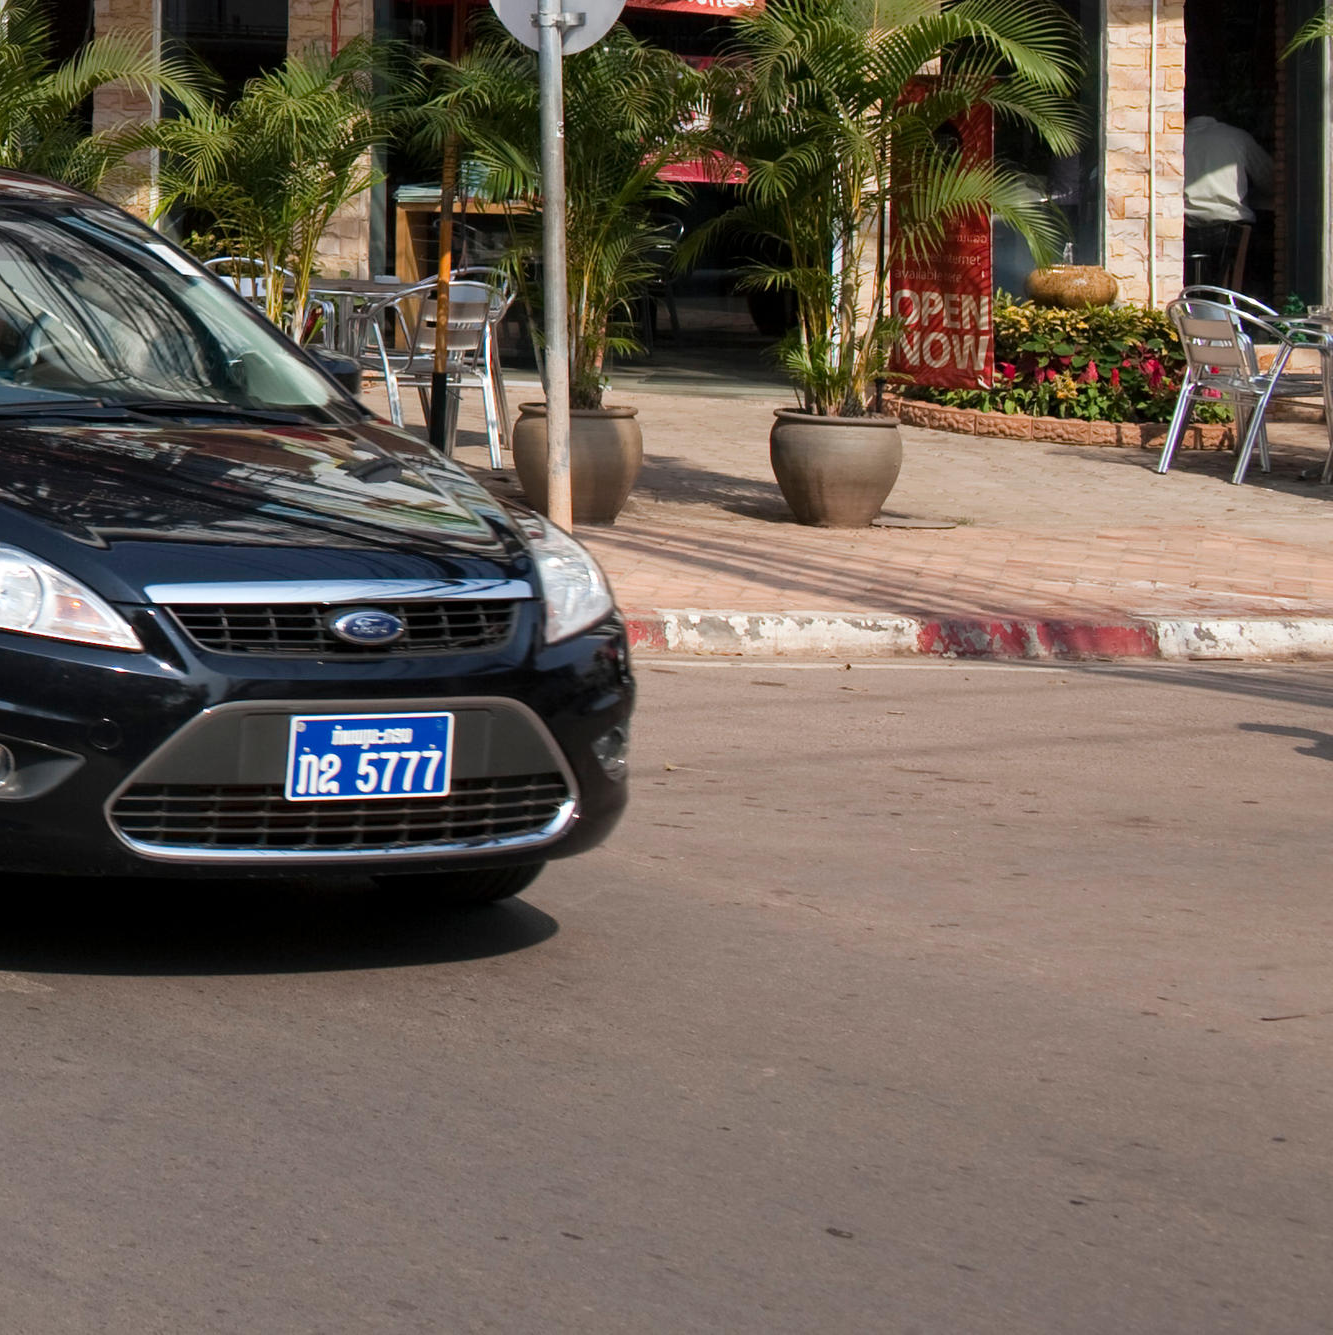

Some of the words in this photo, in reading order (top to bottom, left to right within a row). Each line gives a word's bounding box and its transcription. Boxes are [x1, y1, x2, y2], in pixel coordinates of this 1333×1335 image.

[893, 289, 989, 331] OPEN
[894, 331, 991, 371] NOW
[355, 750, 443, 793] 5777
